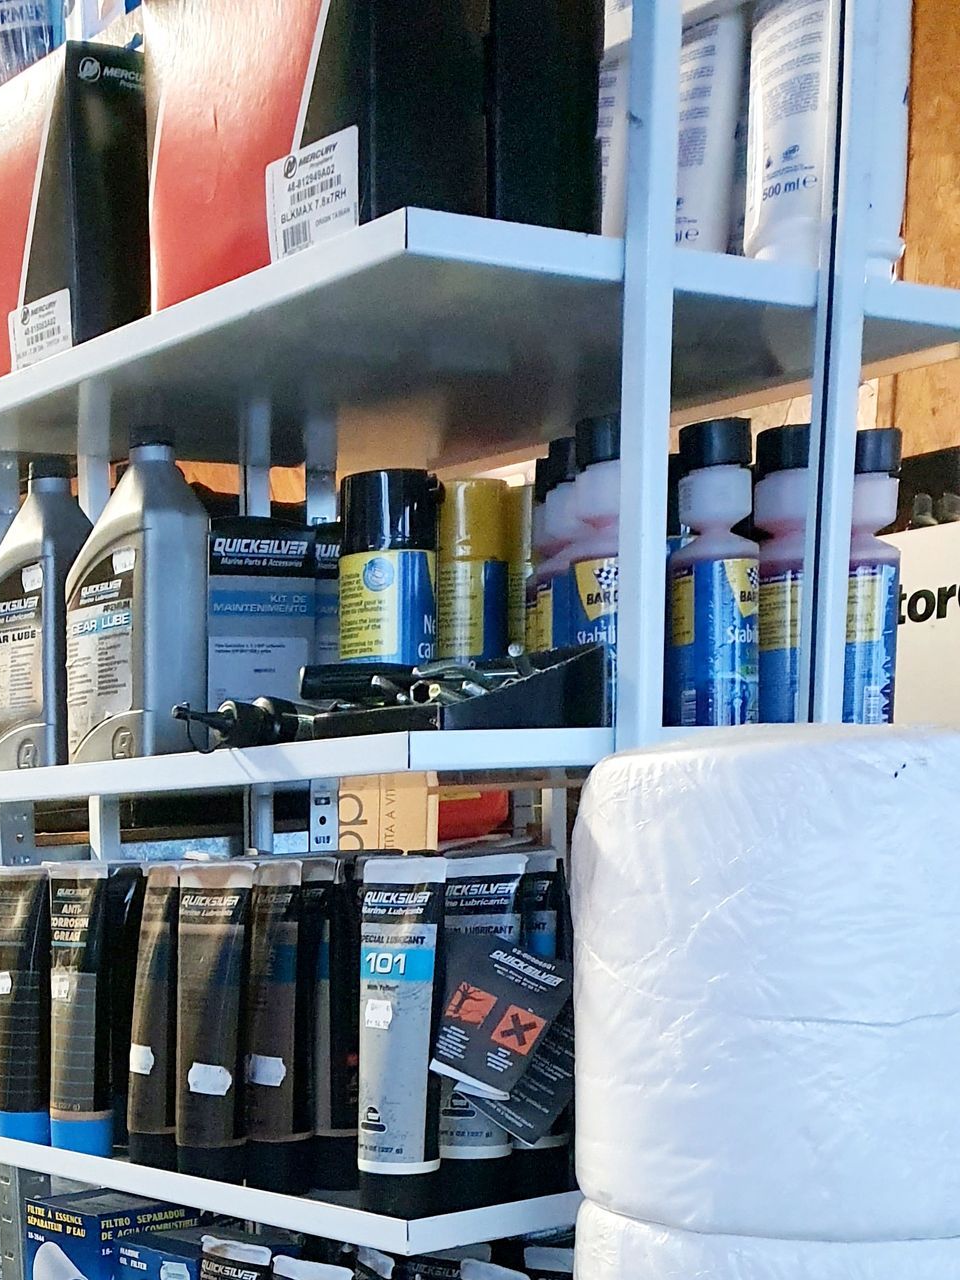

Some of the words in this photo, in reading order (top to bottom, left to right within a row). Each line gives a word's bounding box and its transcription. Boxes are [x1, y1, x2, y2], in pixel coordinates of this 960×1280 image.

[102, 66, 144, 81] MERCU
[298, 142, 338, 167] MERCURY
[783, 178, 800, 193] ml
[281, 203, 313, 225] BLKMAX
[213, 537, 309, 557] QUICKSILVER
[220, 557, 243, 566] Marine
[244, 558, 261, 566] Parts
[267, 559, 303, 568] Accessories
[270, 594, 288, 603] KIT
[292, 595, 308, 603] DE
[898, 584, 960, 626] tor
[72, 619, 97, 635] GEAR
[101, 612, 130, 630] LUBE
[11, 629, 37, 642] LUBE
[181, 895, 240, 907] QUICKSILVER
[364, 891, 431, 906] QUICKSILVER
[459, 897, 509, 907] Lubricants
[365, 952, 407, 975] 101
[489, 949, 565, 987] QUICKSILVER
[27, 1204, 45, 1217] FILTRE
[55, 1211, 83, 1226] ESSENCE
[101, 1216, 131, 1230] FILTRO
[136, 1208, 186, 1224] SEPARADOR
[66, 1225, 86, 1238] D'EAU
[101, 1230, 113, 1241] DE
[119, 1247, 140, 1259] MARINE
[130, 1259, 148, 1271] FILTER
[201, 1259, 260, 1280] QUICKSILVER
